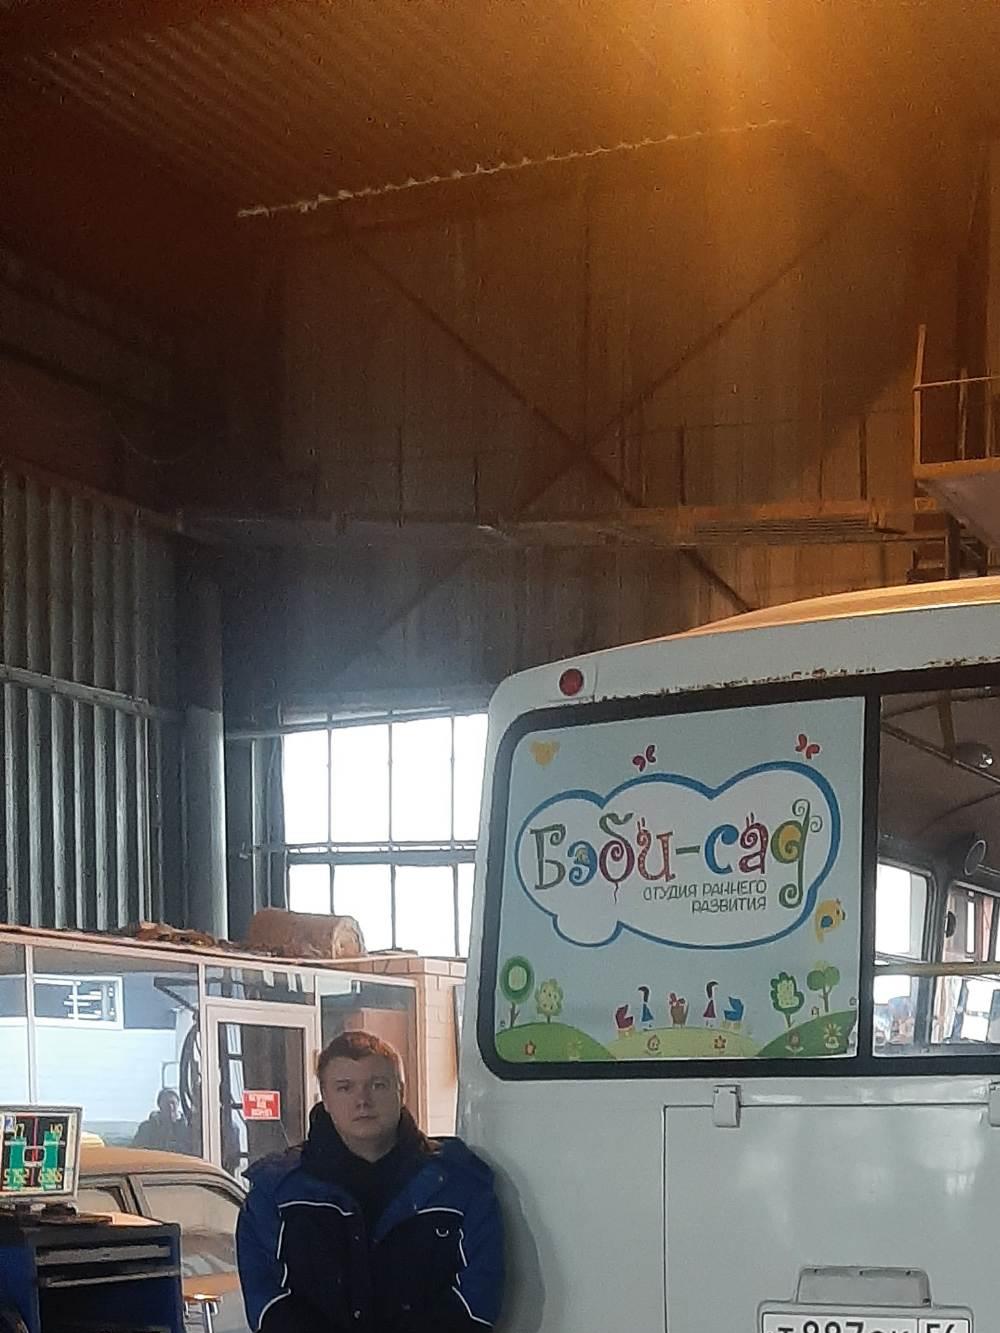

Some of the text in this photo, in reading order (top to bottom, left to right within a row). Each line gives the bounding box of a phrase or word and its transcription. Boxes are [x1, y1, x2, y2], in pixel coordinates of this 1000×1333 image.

[530, 798, 823, 909] Бэби-сад
[642, 879, 767, 901] СТУДИЯ РАННЕГО
[692, 896, 767, 914] РАЗВИТИЯ
